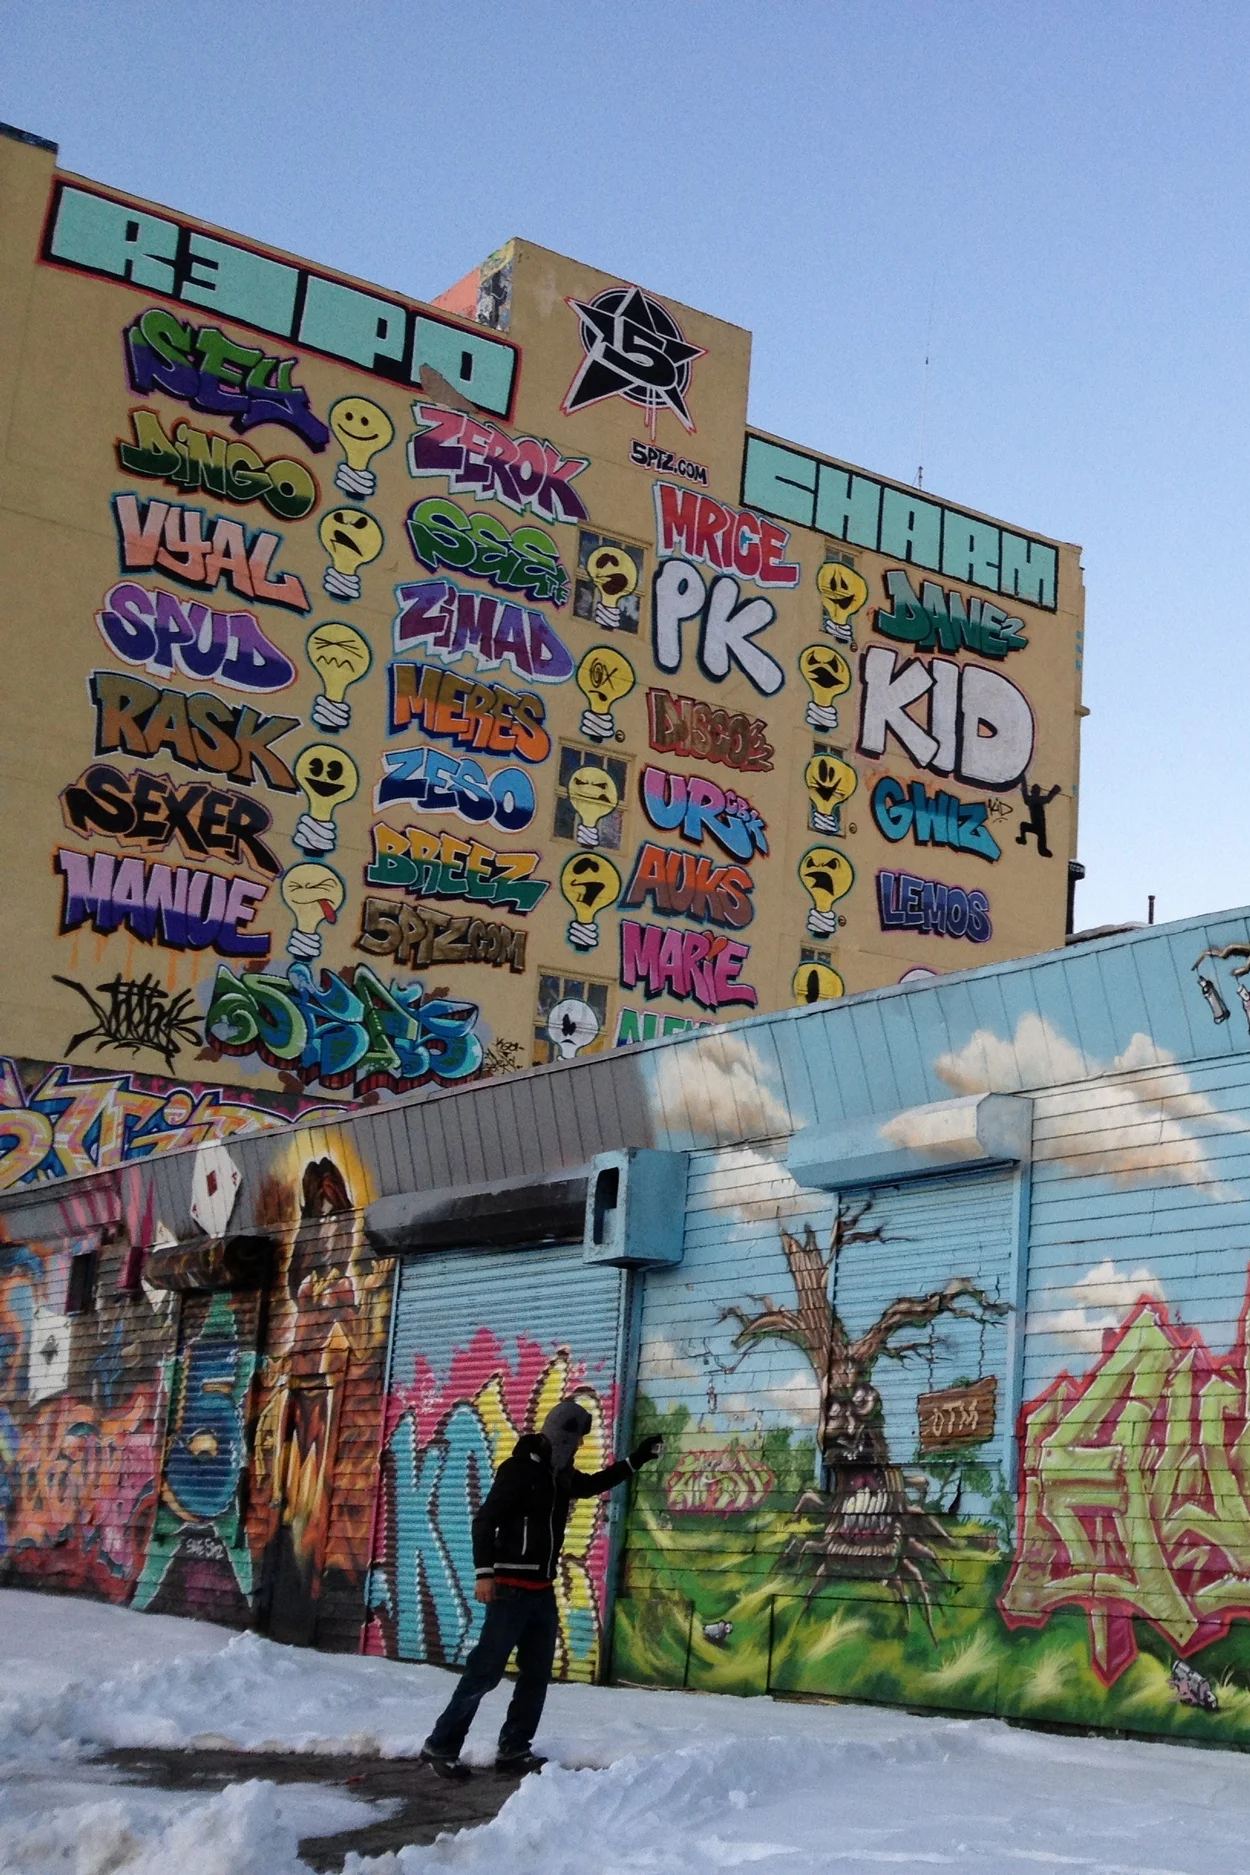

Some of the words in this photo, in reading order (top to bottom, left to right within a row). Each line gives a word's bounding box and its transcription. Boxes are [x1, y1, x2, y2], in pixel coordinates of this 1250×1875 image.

[408, 401, 590, 523] ZEROK
[629, 440, 709, 487] 5PTZ.COM
[740, 430, 1059, 614] CHARM
[97, 584, 299, 694] SPUD
[653, 558, 786, 696] PK
[88, 670, 303, 796] RASK
[390, 662, 551, 763] MERES
[857, 645, 1035, 793] KID
[60, 765, 282, 877] SEXER
[375, 747, 537, 833] ZESO
[871, 776, 1001, 863] GWIZ
[55, 848, 272, 958] MANUE
[366, 825, 550, 911] BREEZ
[876, 869, 993, 944] LEMOS
